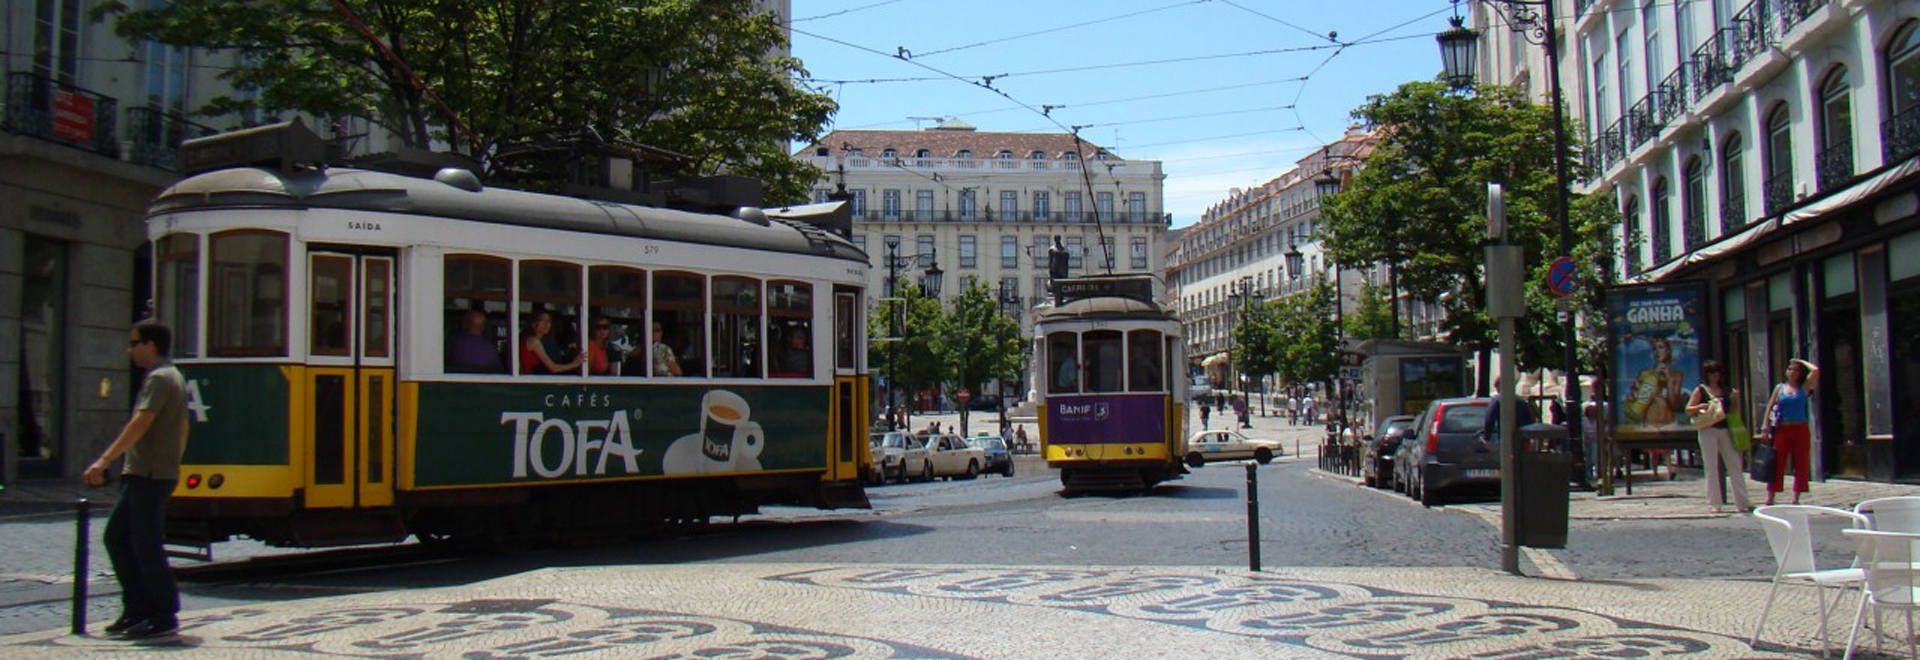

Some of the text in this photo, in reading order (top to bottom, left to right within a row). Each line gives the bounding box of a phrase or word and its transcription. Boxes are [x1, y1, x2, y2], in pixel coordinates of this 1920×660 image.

[1626, 305, 1684, 323] GANHA
[545, 392, 610, 407] CAFÉS
[1059, 404, 1091, 415] BANIF
[501, 409, 644, 478] TOFA
[704, 437, 728, 457] TOFA
